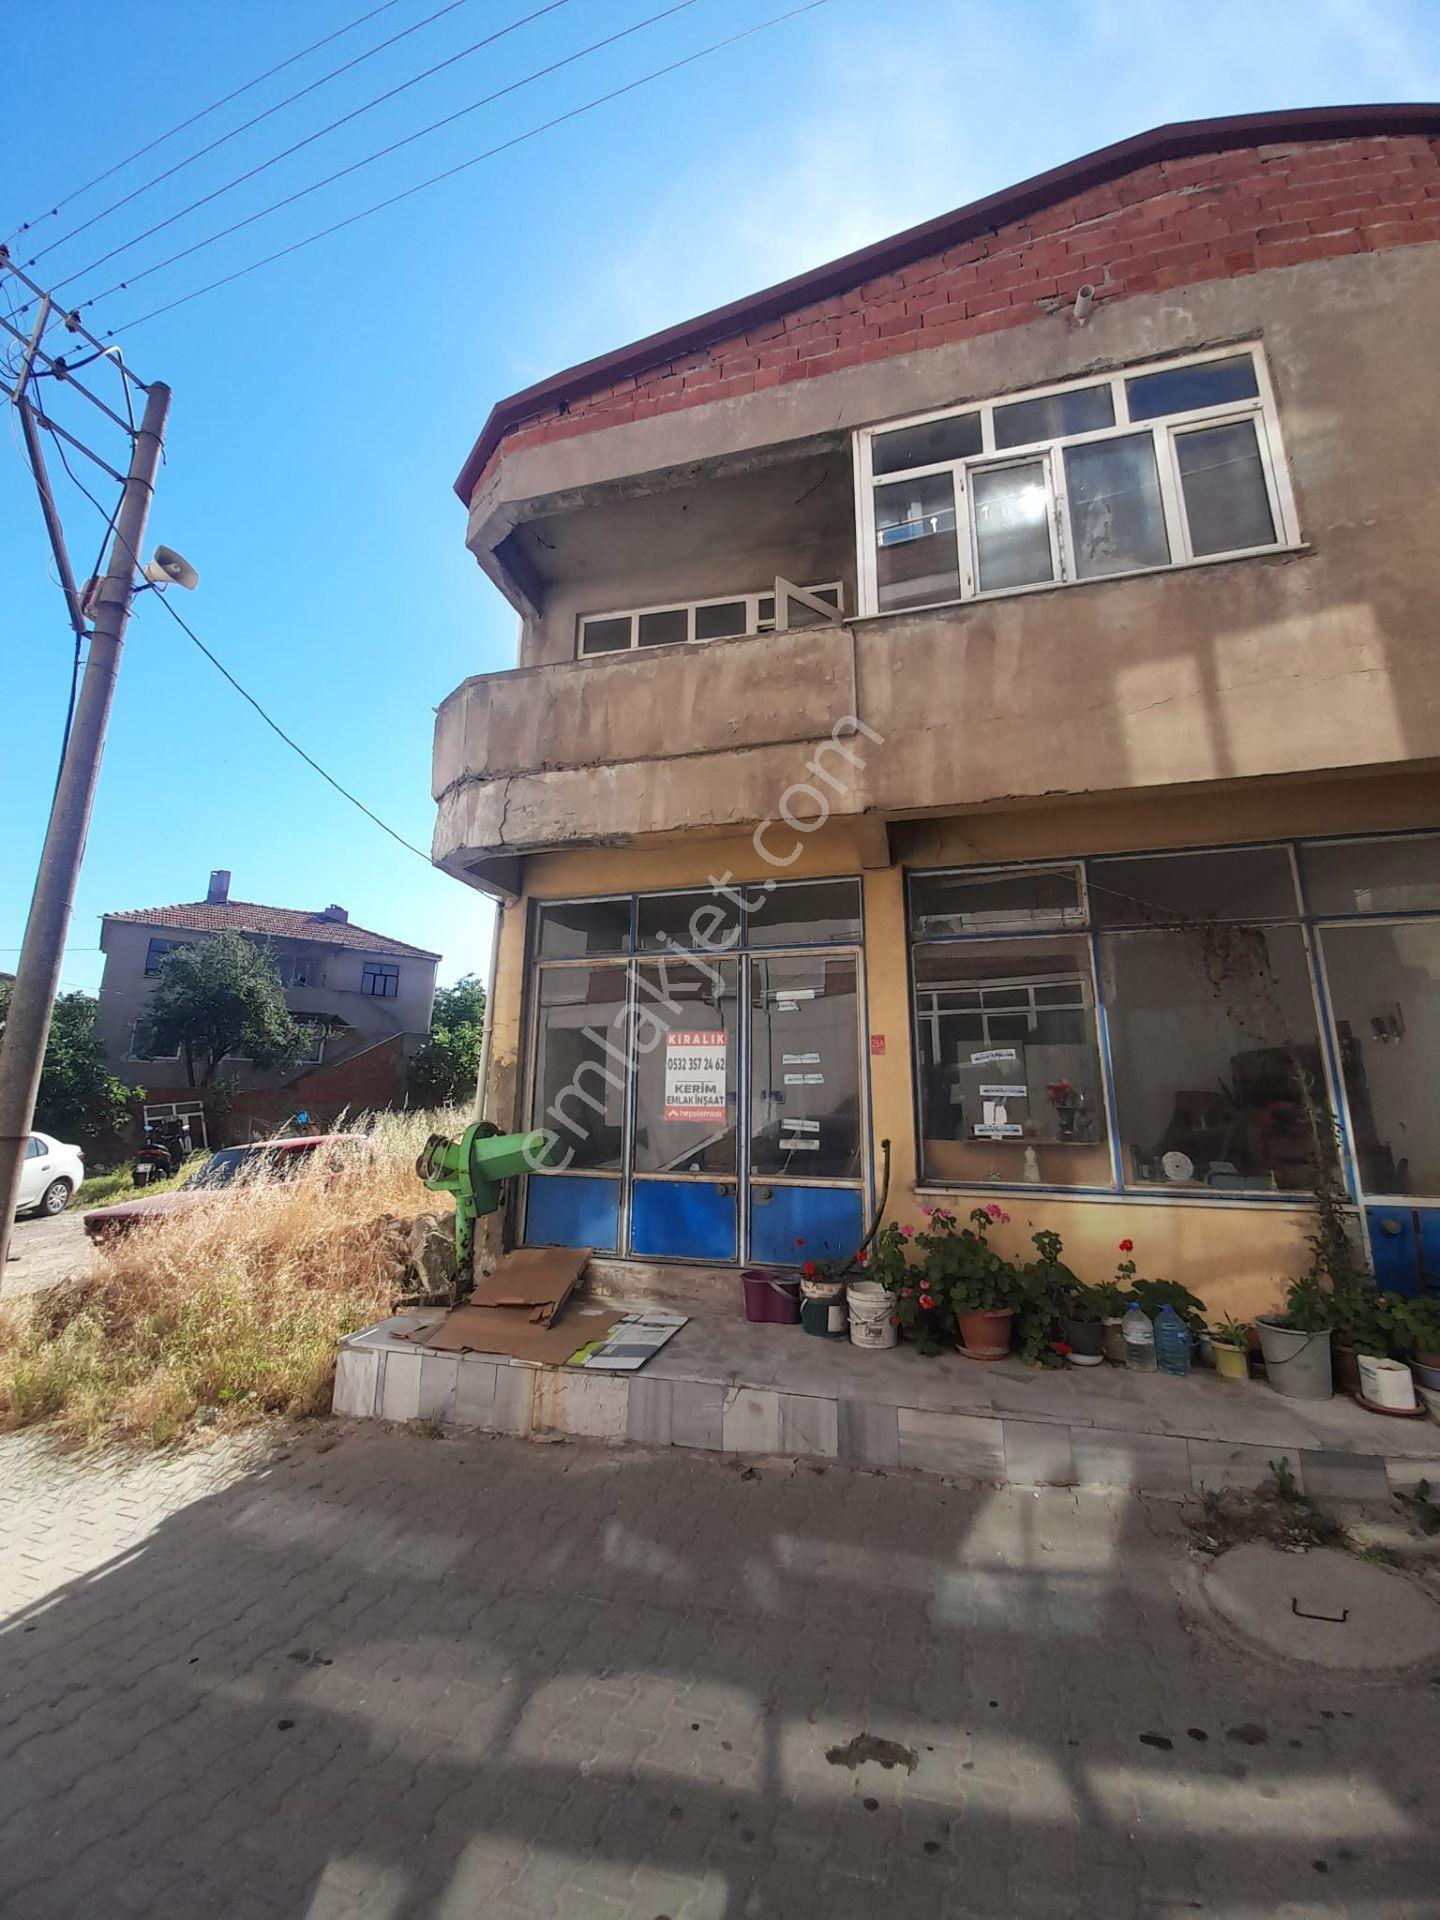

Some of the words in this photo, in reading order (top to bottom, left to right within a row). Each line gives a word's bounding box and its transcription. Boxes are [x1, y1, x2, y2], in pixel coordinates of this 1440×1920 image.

[668, 1034, 724, 1045] KIRALIK
[668, 1058, 686, 1071] 0532
[689, 1058, 701, 1071] 357
[704, 1058, 713, 1070] 24
[715, 1058, 725, 1071] 62
[674, 1082, 717, 1094] KERİM
[666, 1095, 694, 1105] EMLAK
[694, 1094, 725, 1106] İNŞAAT
